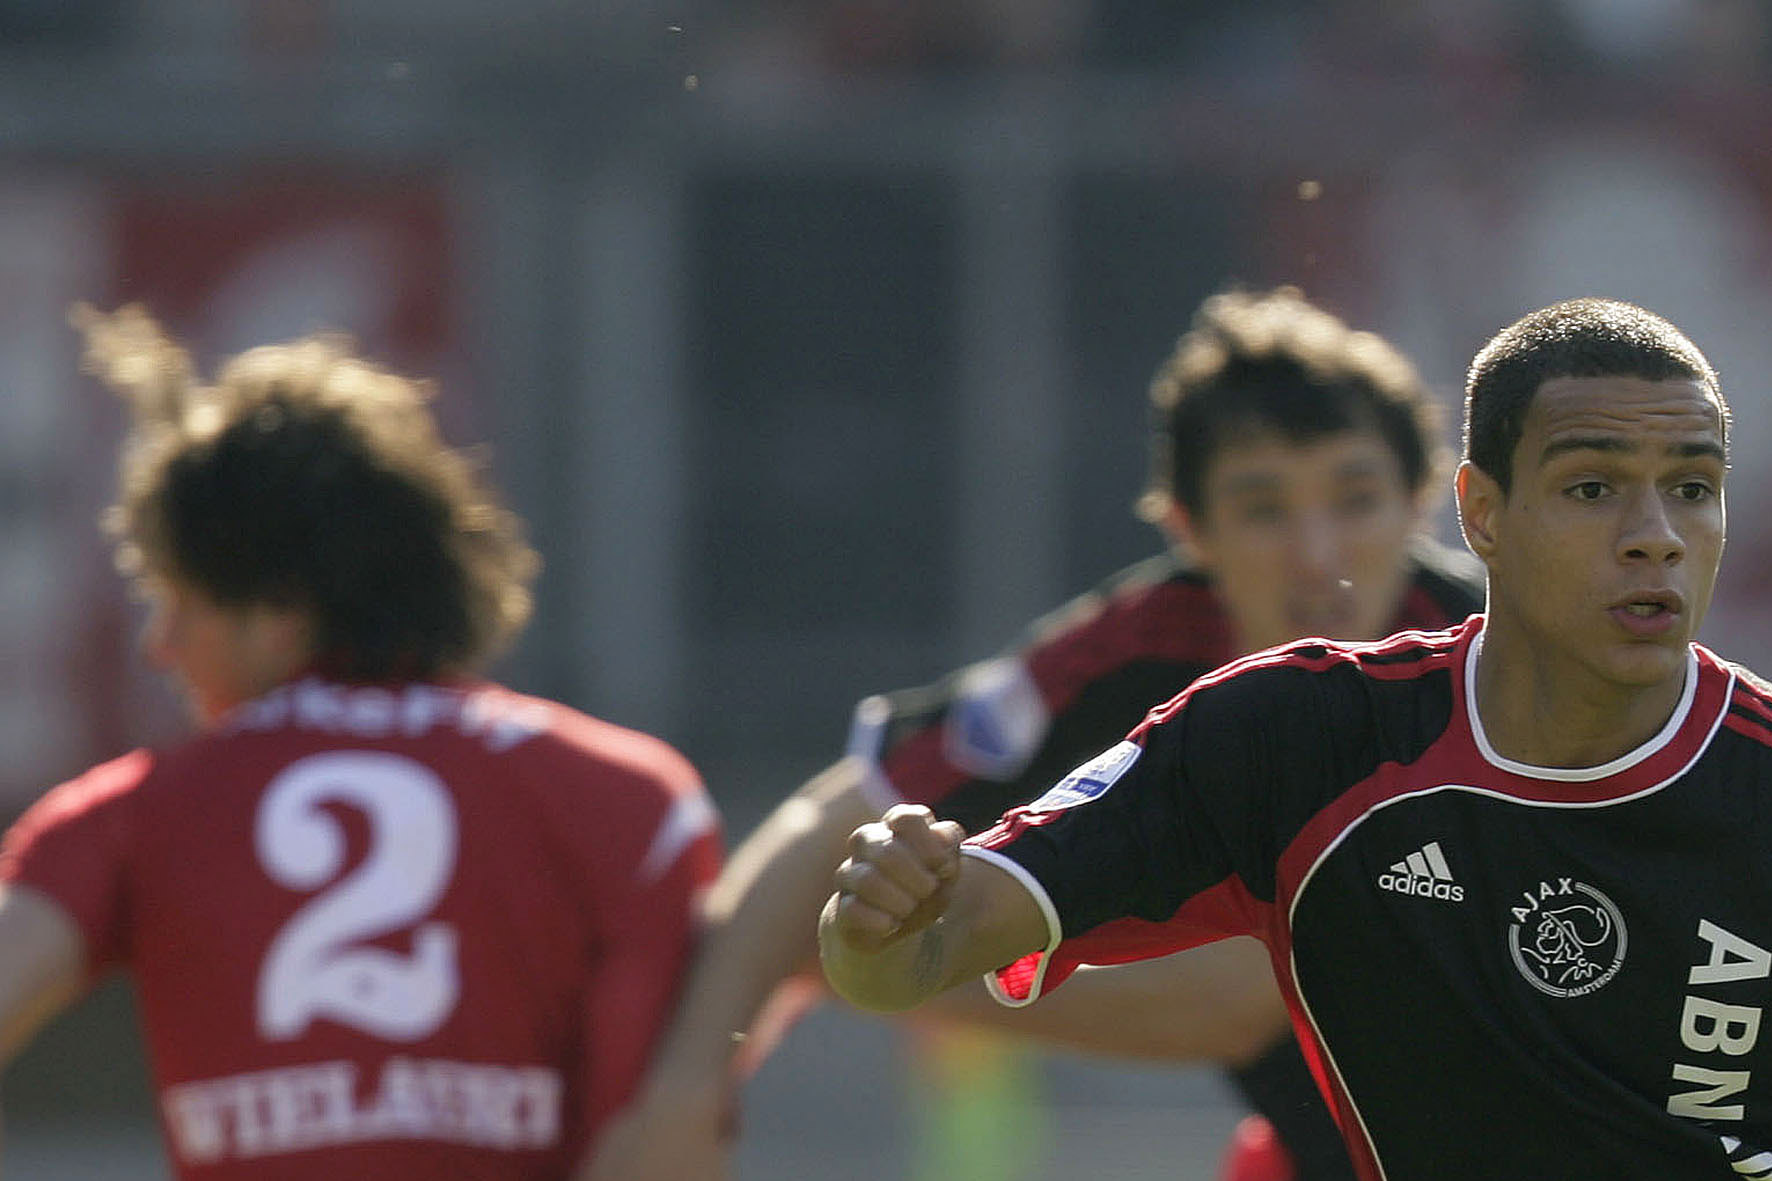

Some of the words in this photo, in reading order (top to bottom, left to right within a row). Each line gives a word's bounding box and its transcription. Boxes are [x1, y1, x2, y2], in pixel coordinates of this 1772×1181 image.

[255, 749, 461, 1042] 2
[1378, 873, 1464, 902] adidas
[1511, 877, 1574, 924] AJAX
[1566, 960, 1622, 998] AMSTERDAM
